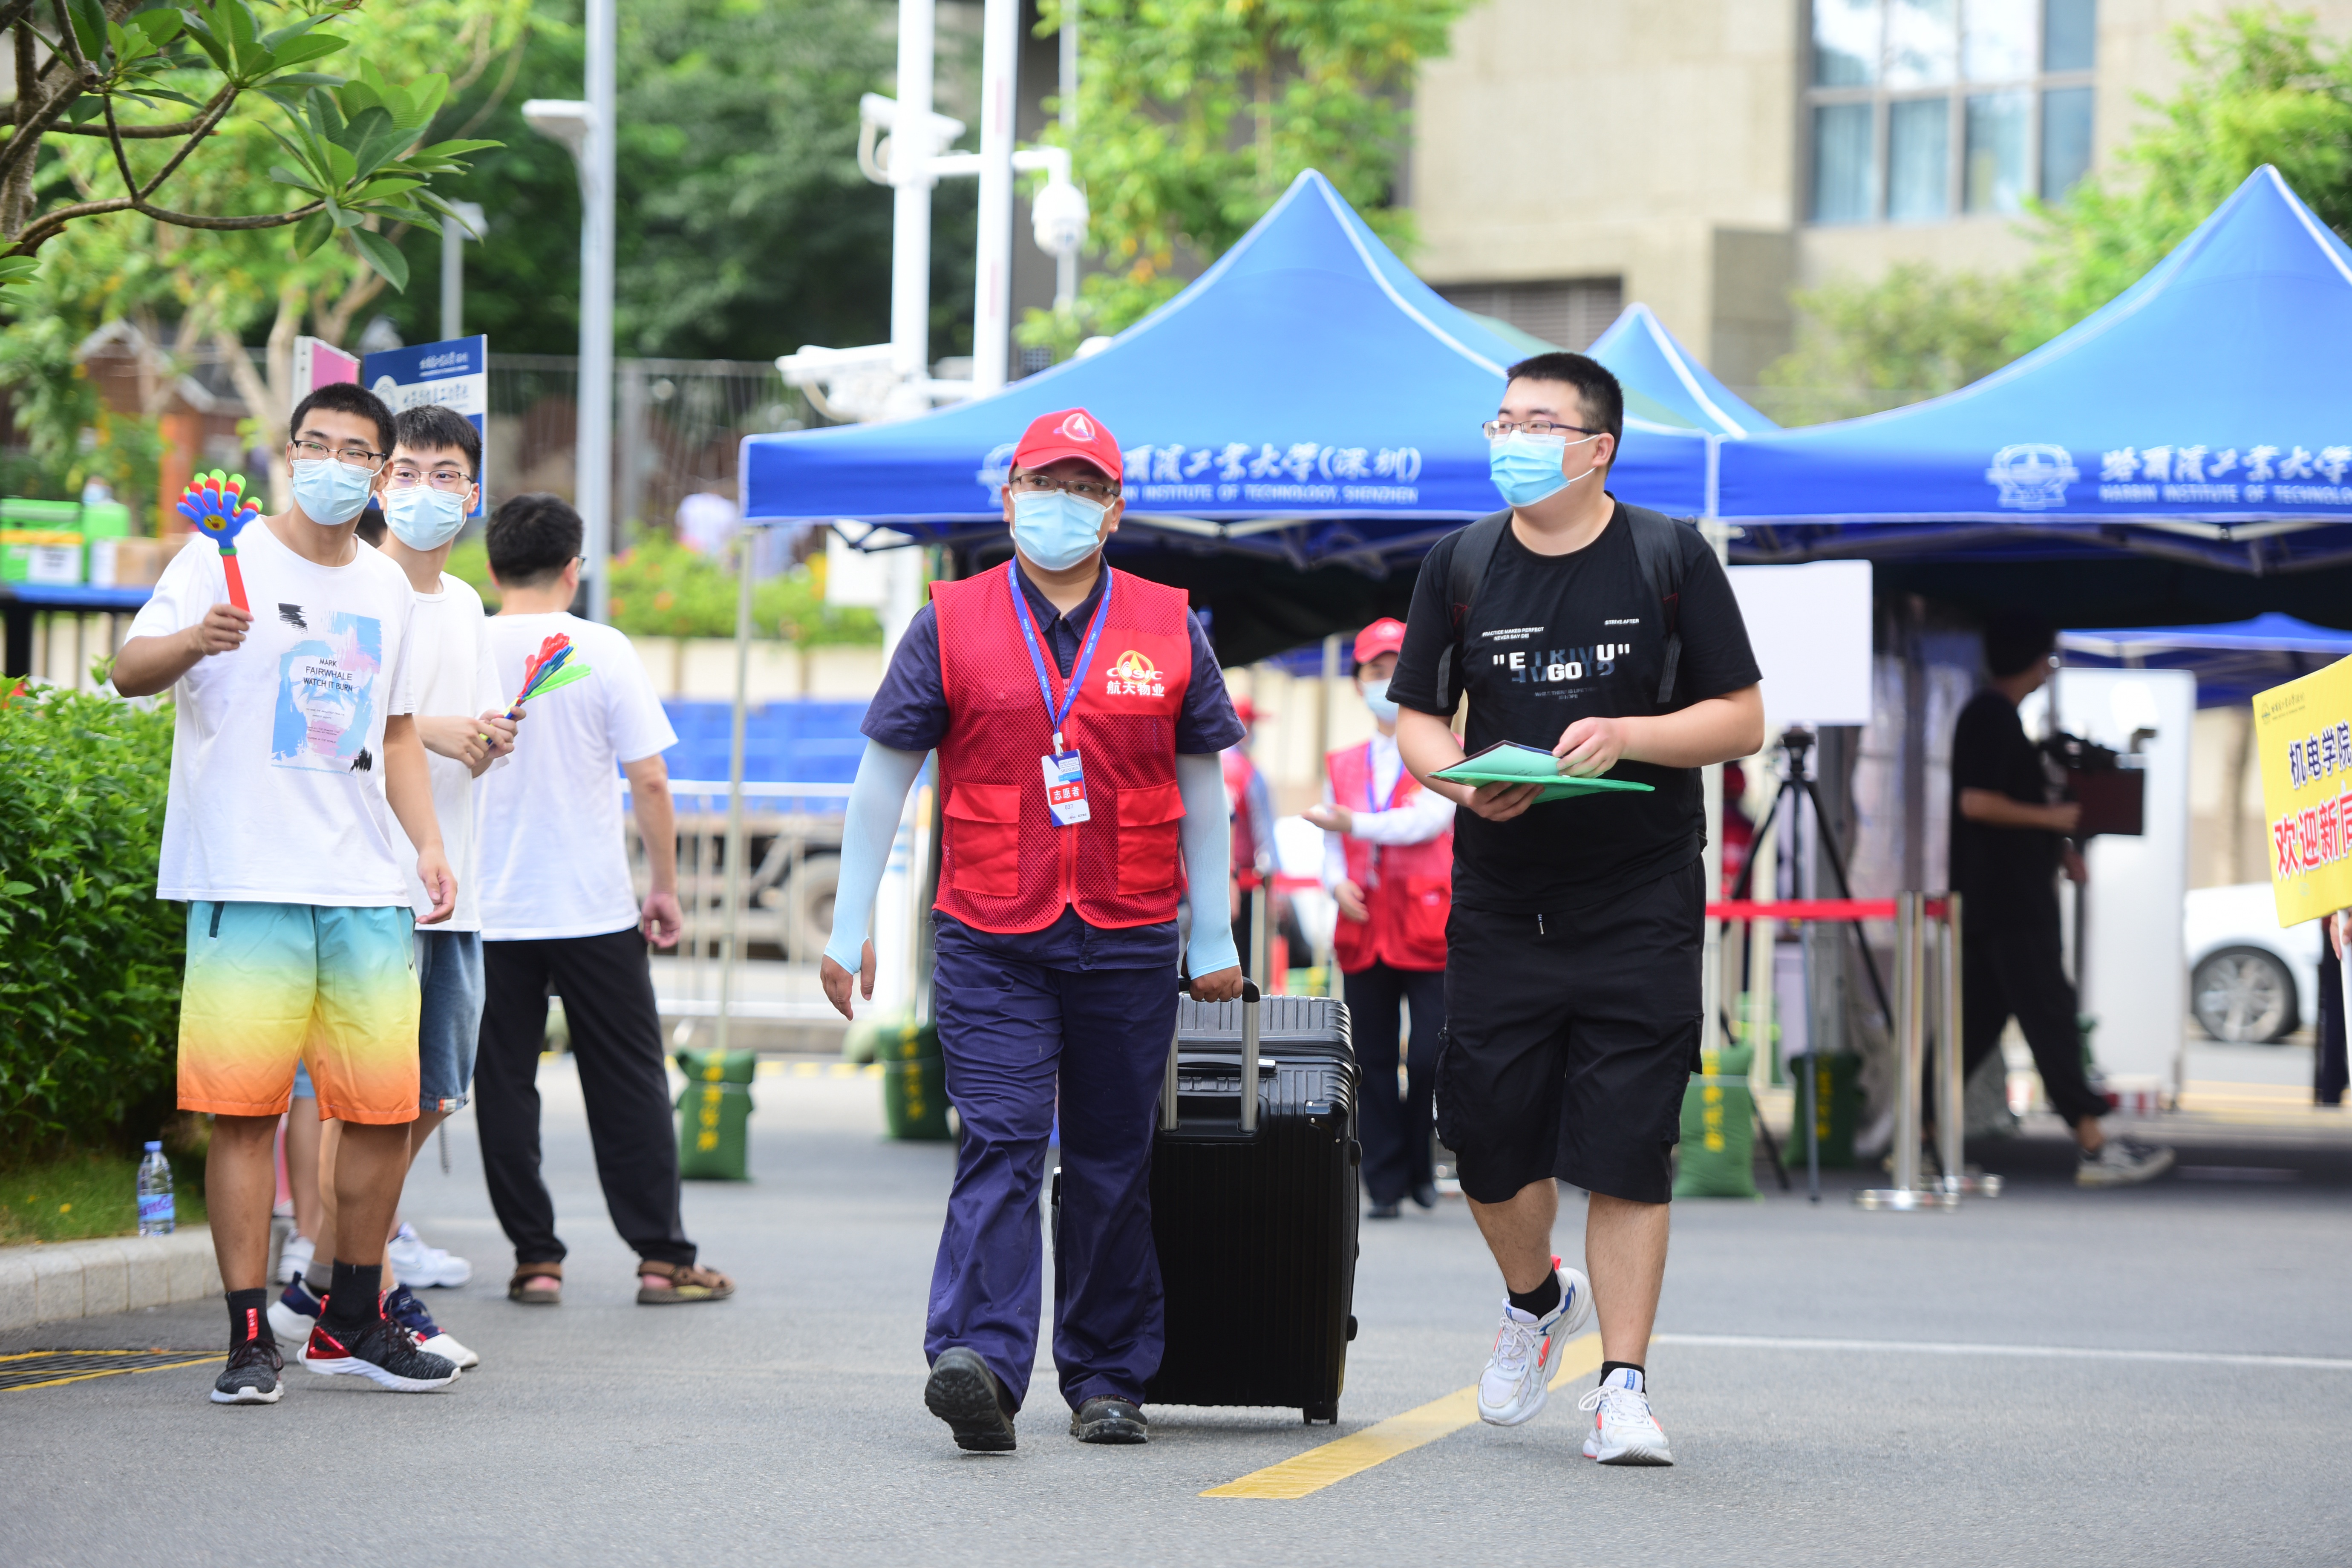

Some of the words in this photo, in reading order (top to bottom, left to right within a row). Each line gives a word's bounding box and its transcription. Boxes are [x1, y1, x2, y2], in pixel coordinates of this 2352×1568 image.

[1142, 484, 1214, 503] INSTITUTE
[1217, 484, 1239, 502] OF
[1342, 485, 1419, 504] SHENZHEN
[2098, 484, 2158, 504] HARBIN
[2162, 484, 2240, 504] INSTITUTE
[2242, 484, 2266, 504] OF
[1482, 629, 1504, 637] PRACTICE
[319, 658, 337, 667] MARK
[306, 666, 353, 680] FAIRWHALE
[303, 677, 326, 687] WATCH
[336, 683, 353, 692] BURN
[1107, 680, 1164, 697] 航天物业
[2289, 720, 2352, 789] 机电学院
[1053, 786, 1080, 800] 志愿者
